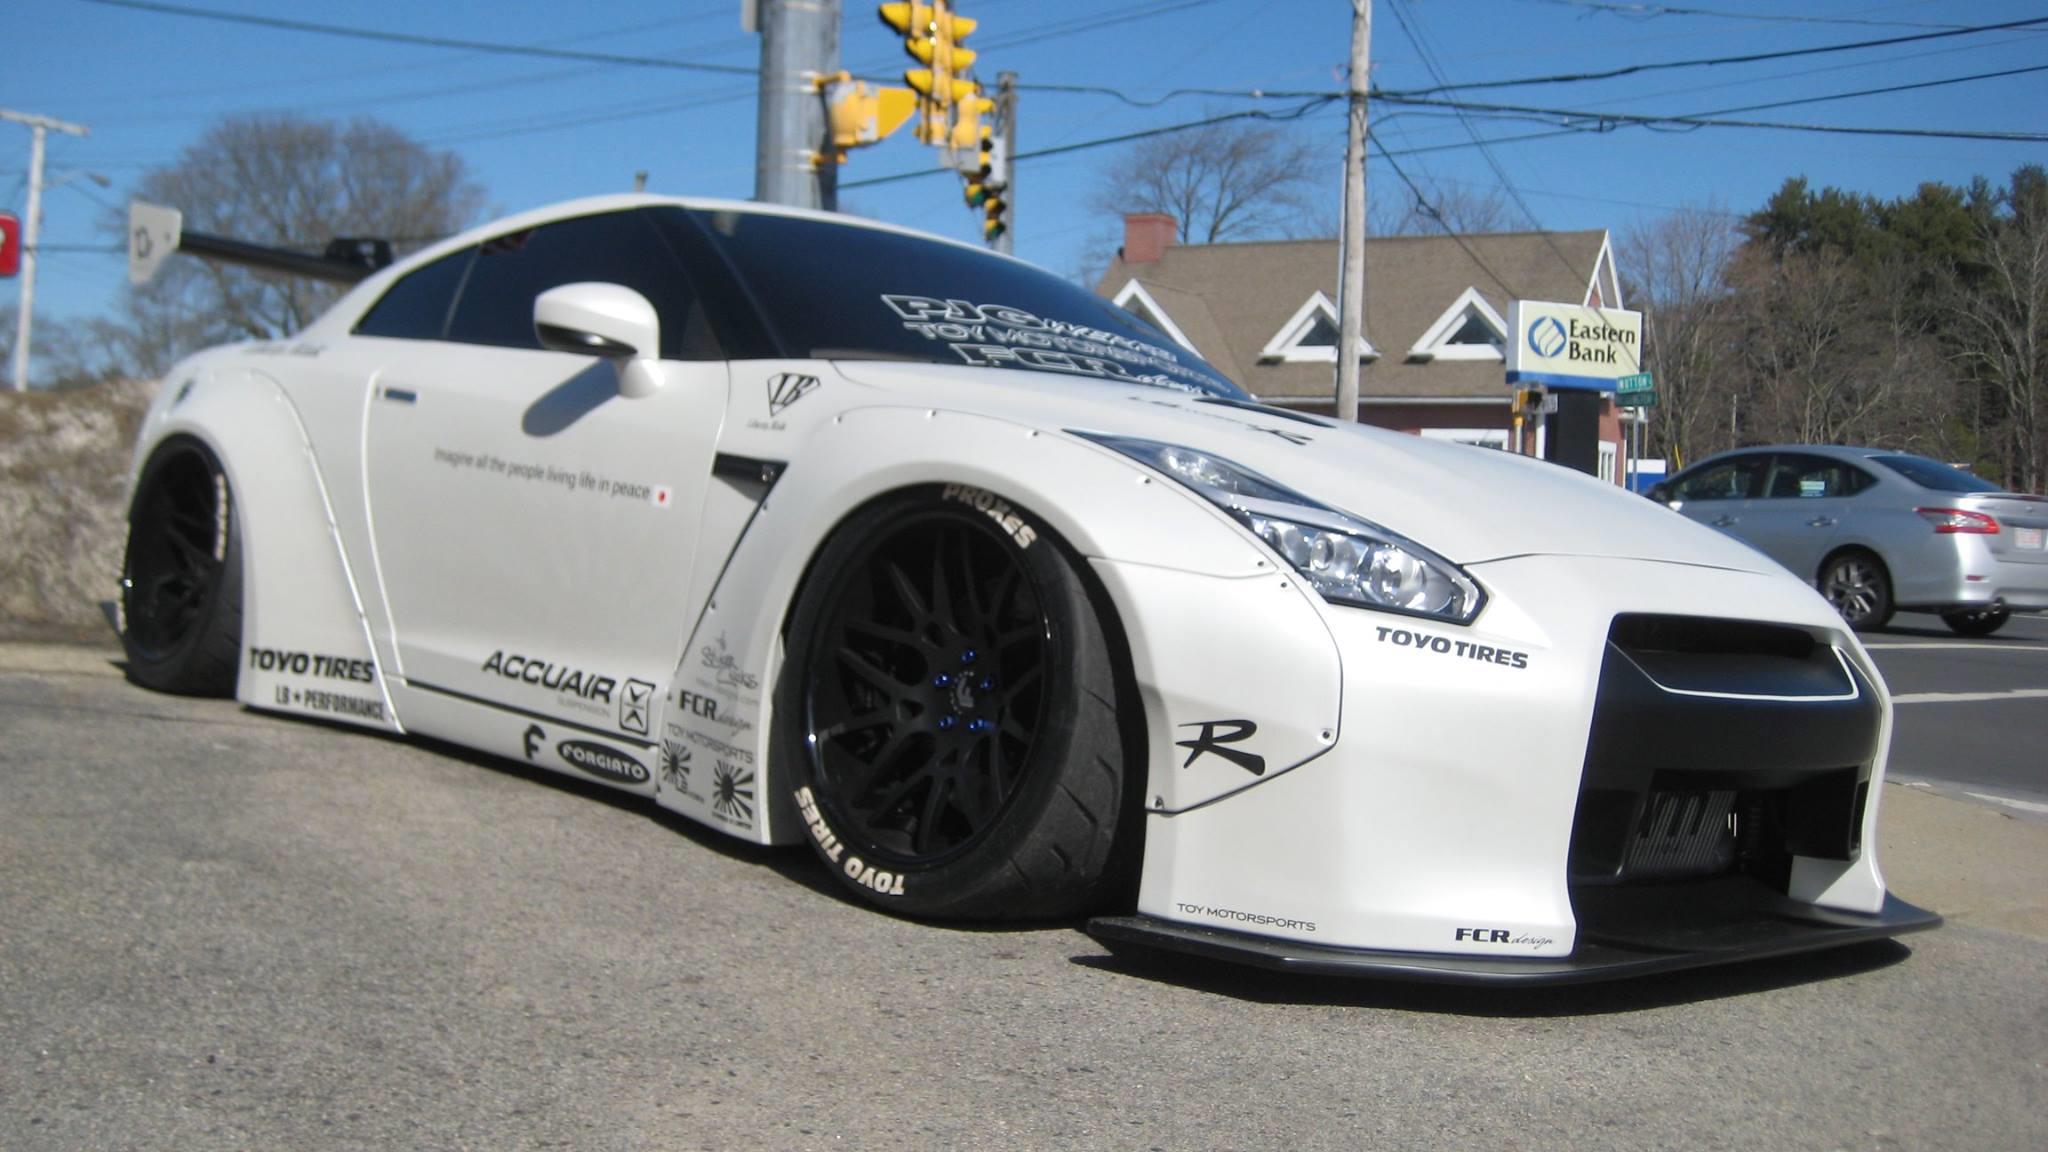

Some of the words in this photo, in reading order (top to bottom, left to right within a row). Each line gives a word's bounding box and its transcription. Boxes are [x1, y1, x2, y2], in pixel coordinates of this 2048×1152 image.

[1569, 318, 1635, 344] Eastern
[1569, 341, 1617, 364] Bank
[434, 447, 473, 468] Imagine
[476, 456, 488, 469] all
[489, 458, 505, 472] the
[507, 462, 544, 481] people
[547, 466, 577, 490] living
[579, 472, 596, 489] life
[599, 477, 609, 492] in
[611, 481, 650, 499] peace
[942, 484, 1037, 549] PROXES
[1376, 626, 1451, 654] TOYO
[1455, 641, 1528, 669] TIRES
[249, 648, 308, 674] TOYO
[313, 655, 374, 683] TIRES
[482, 650, 616, 704] ACCUAIR
[304, 689, 384, 720] PERFORMANCE
[679, 689, 717, 721] FCR
[562, 744, 645, 779] FORGIATO
[687, 730, 754, 764] MOTORSPORTS
[1175, 719, 1265, 776] R
[793, 786, 845, 863] TIRES
[844, 857, 904, 895] TOYO
[1177, 903, 1205, 915] TOY
[1207, 907, 1316, 931] MOTORSPORTS
[1455, 928, 1510, 944] FCR
[1511, 931, 1555, 950] design
